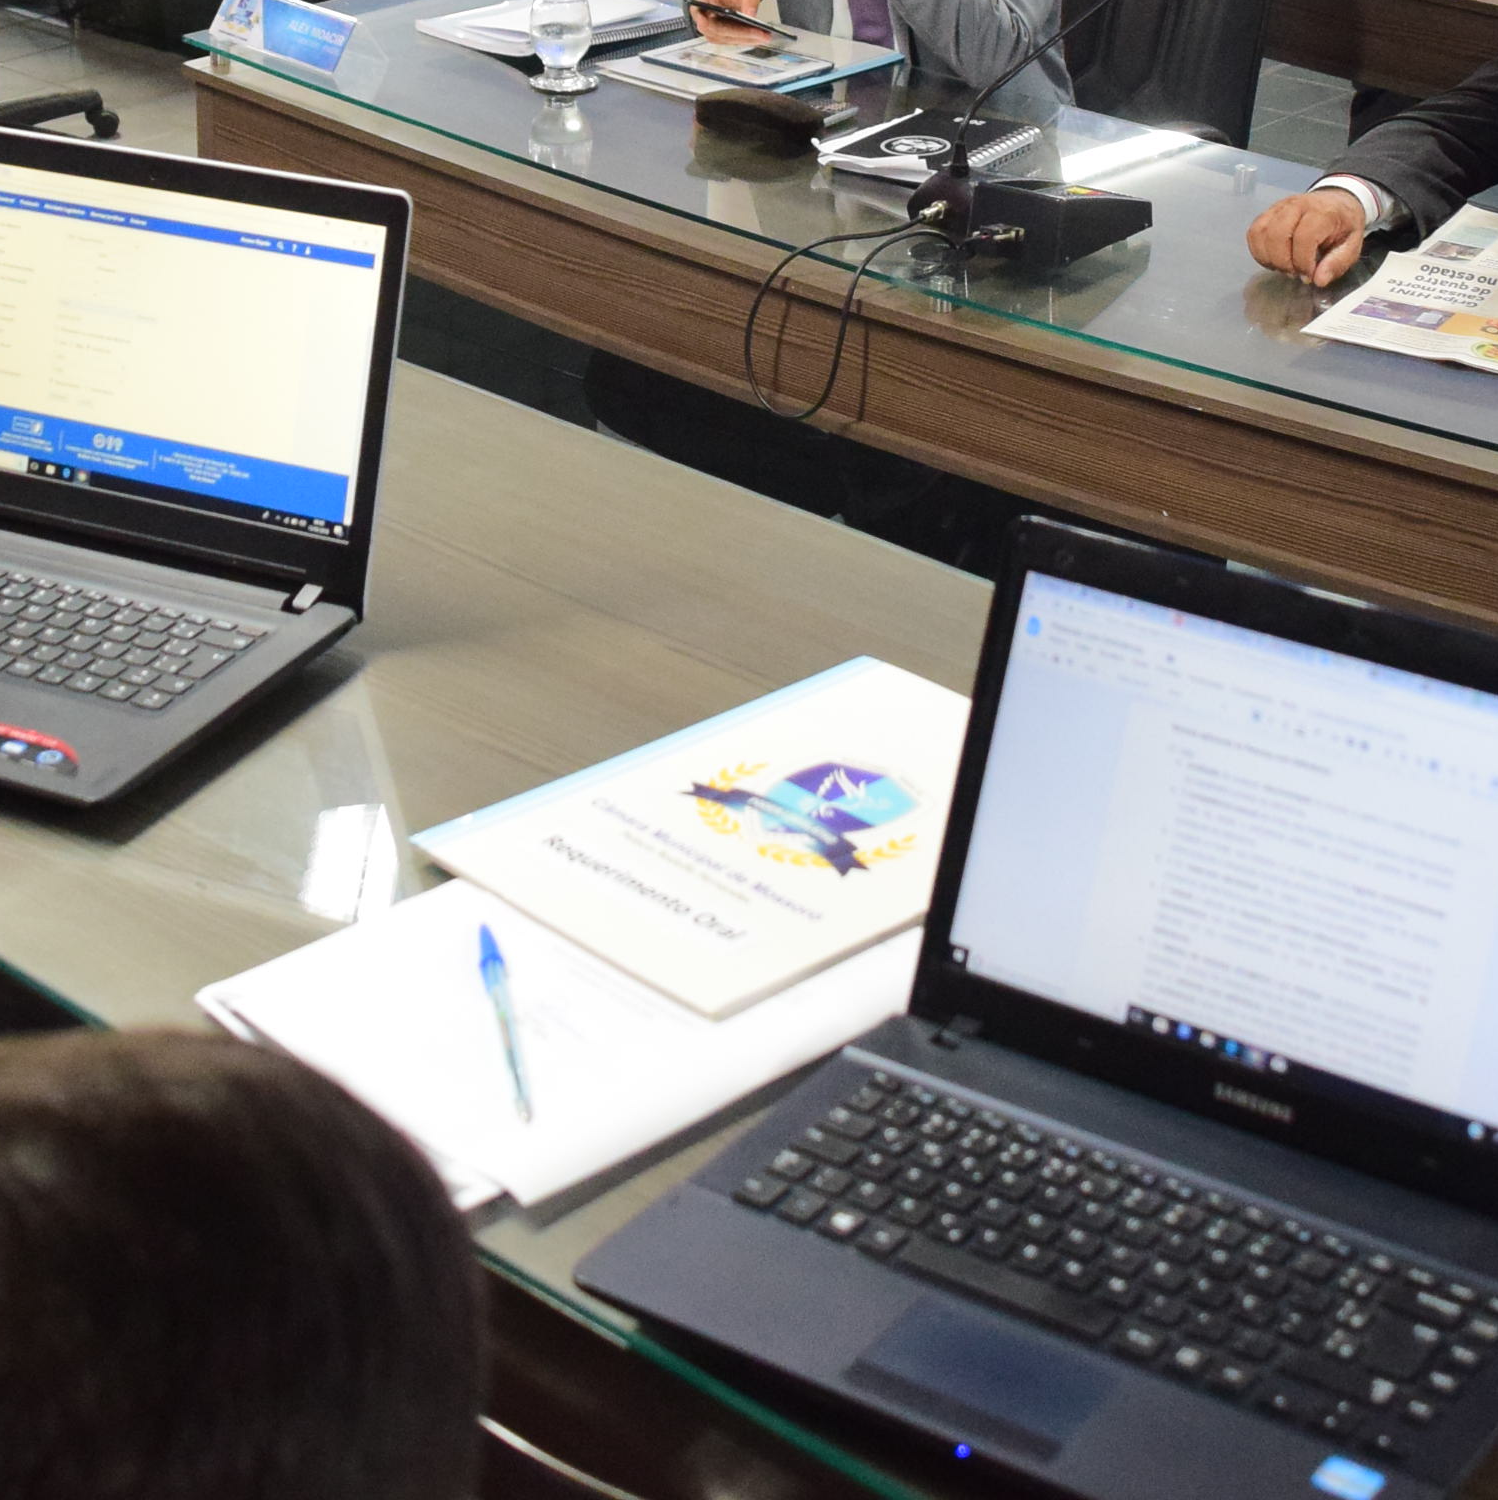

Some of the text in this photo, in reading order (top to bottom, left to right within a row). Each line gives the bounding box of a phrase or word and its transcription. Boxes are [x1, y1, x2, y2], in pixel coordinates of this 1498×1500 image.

[1414, 275, 1492, 296] de quatro
[1420, 264, 1498, 286] no estado
[1387, 278, 1485, 301] causa morte
[1389, 286, 1478, 308] Gripe H1N1
[543, 835, 692, 916] Requerimento
[692, 911, 748, 940] Oral
